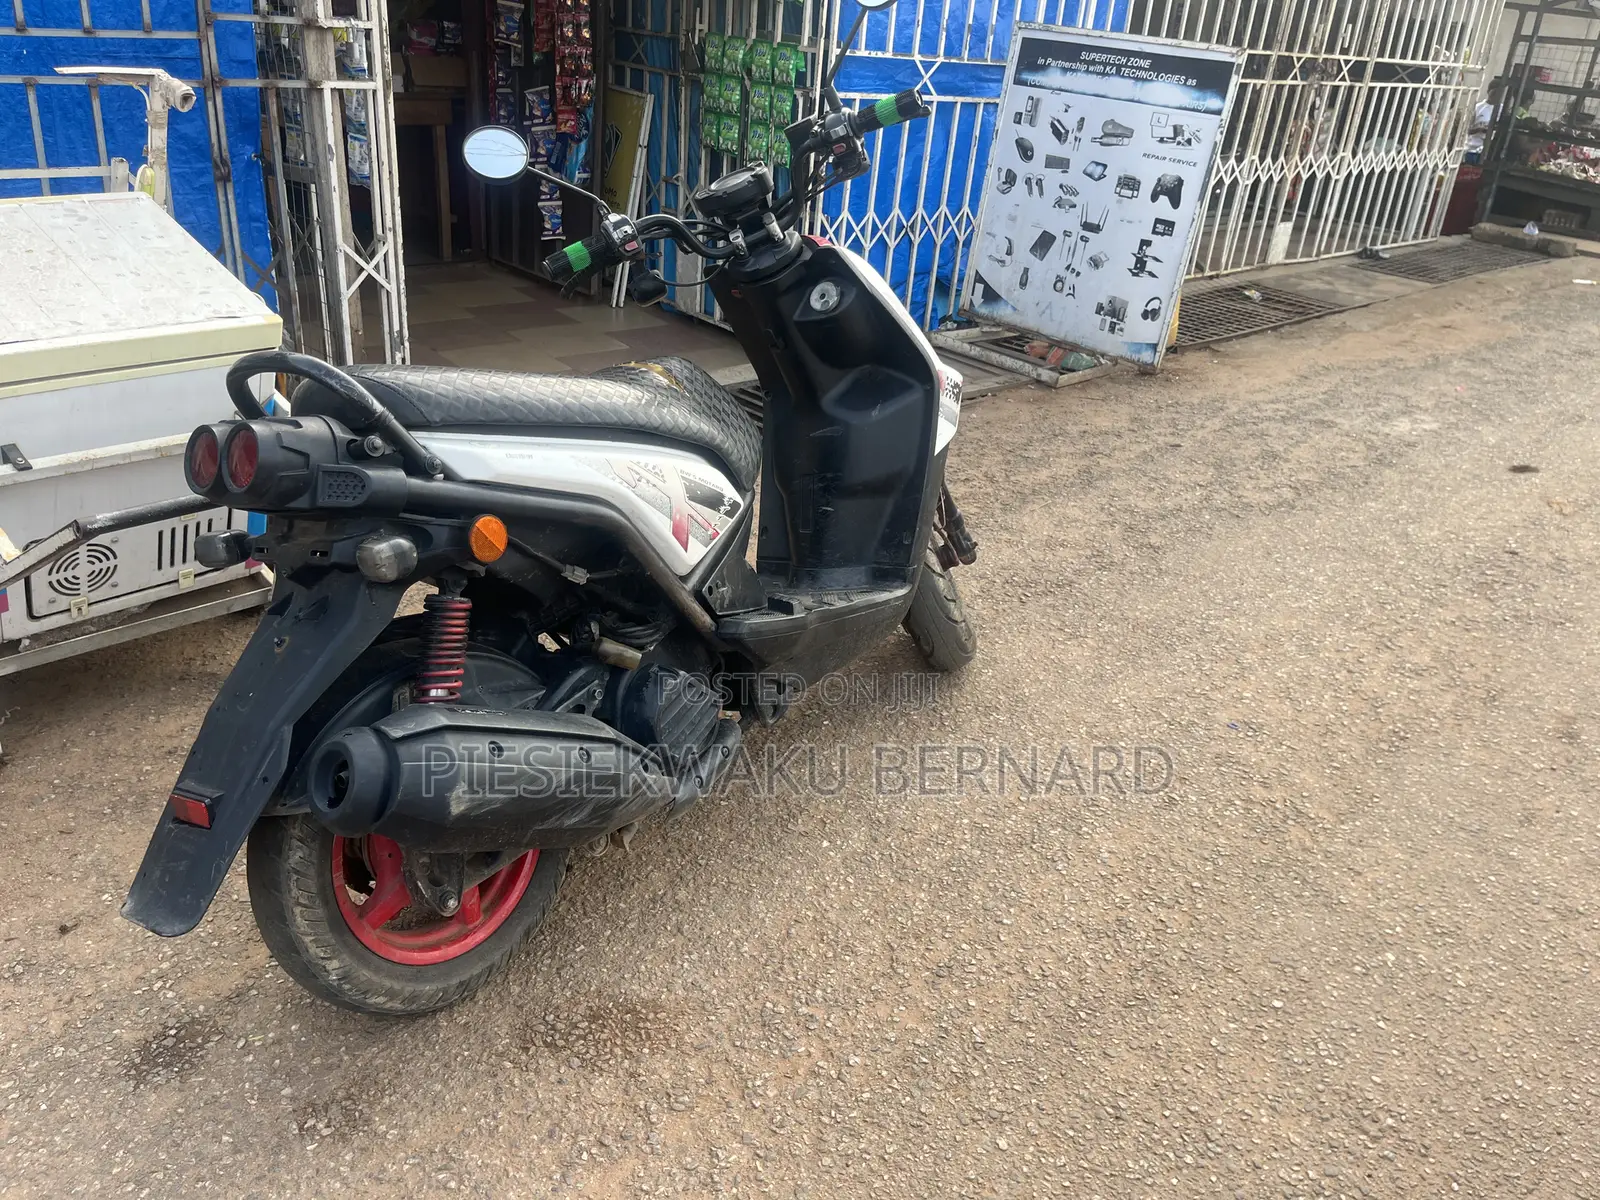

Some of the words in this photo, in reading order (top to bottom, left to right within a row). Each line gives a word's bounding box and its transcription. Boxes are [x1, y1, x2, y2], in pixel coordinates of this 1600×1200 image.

[1080, 51, 1127, 66] SUPERTECH
[1127, 57, 1152, 69] ZONE
[1037, 56, 1045, 65] in
[1045, 57, 1088, 72] Partnership
[1088, 63, 1104, 74] with
[1104, 65, 1117, 75] KA
[1120, 67, 1186, 86] TECHNOLOGIES
[1186, 78, 1197, 87] as
[1142, 152, 1168, 163] REPAIR
[1168, 157, 1199, 168] SERVICE
